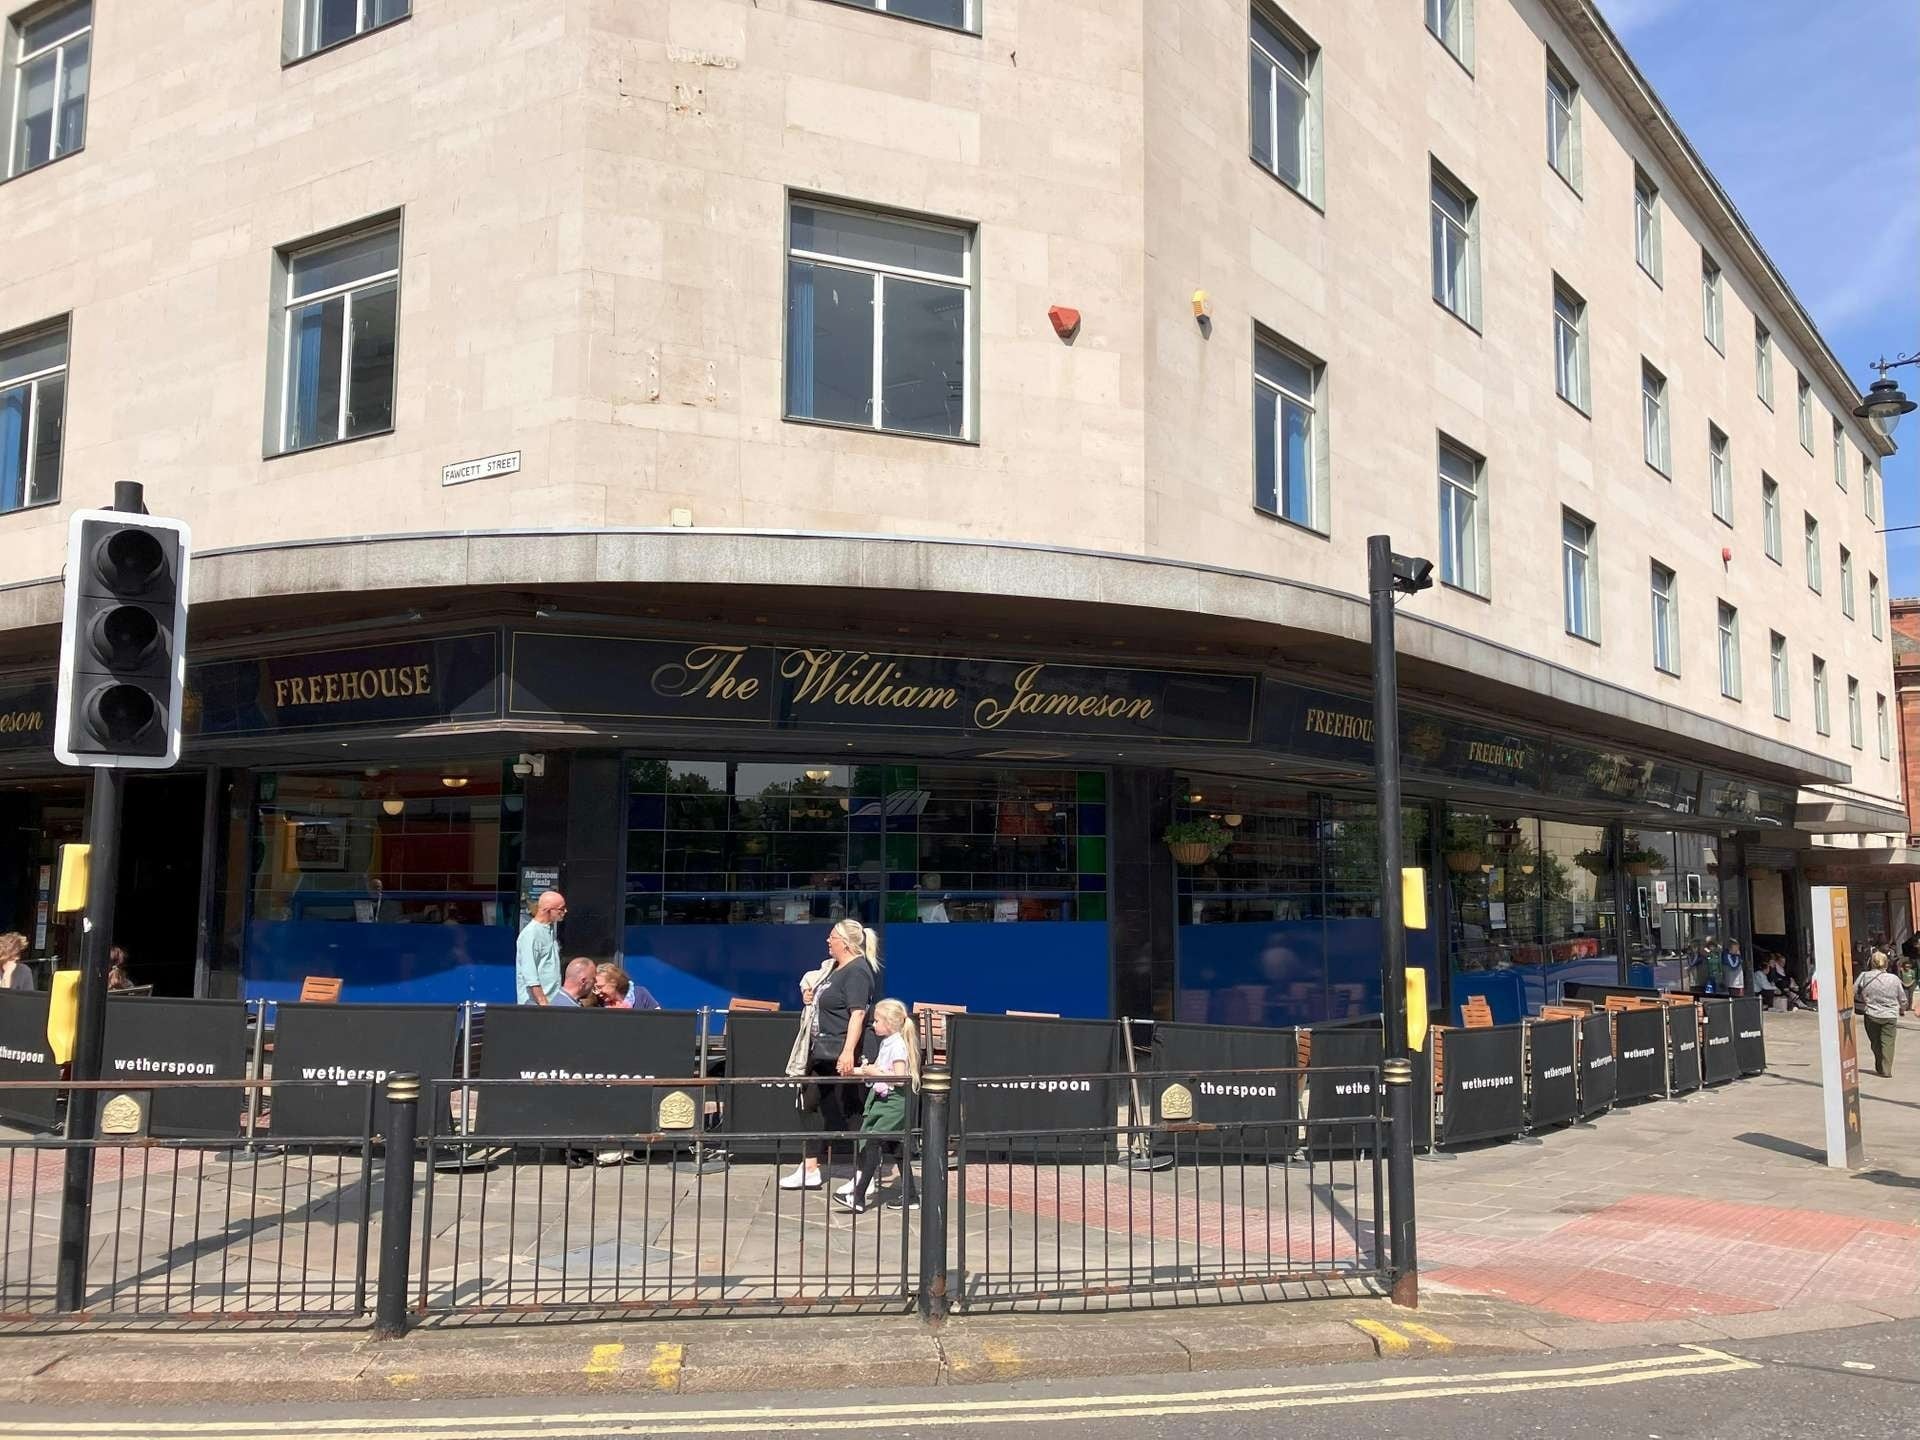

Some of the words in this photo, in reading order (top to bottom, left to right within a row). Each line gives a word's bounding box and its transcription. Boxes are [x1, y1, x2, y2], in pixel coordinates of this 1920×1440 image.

[445, 464, 480, 480] FAWCETT
[487, 457, 517, 471] STREET
[274, 664, 430, 707] FREEHOUSE
[651, 645, 759, 699] The
[781, 649, 959, 709] William
[974, 663, 1154, 729] Jameson
[1306, 708, 1376, 742] FREEHOU
[114, 1058, 214, 1075] wetherspoon
[302, 1066, 396, 1083] wethersp
[1200, 1082, 1276, 1098] therspoon
[1462, 1076, 1514, 1090] wetherspoon
